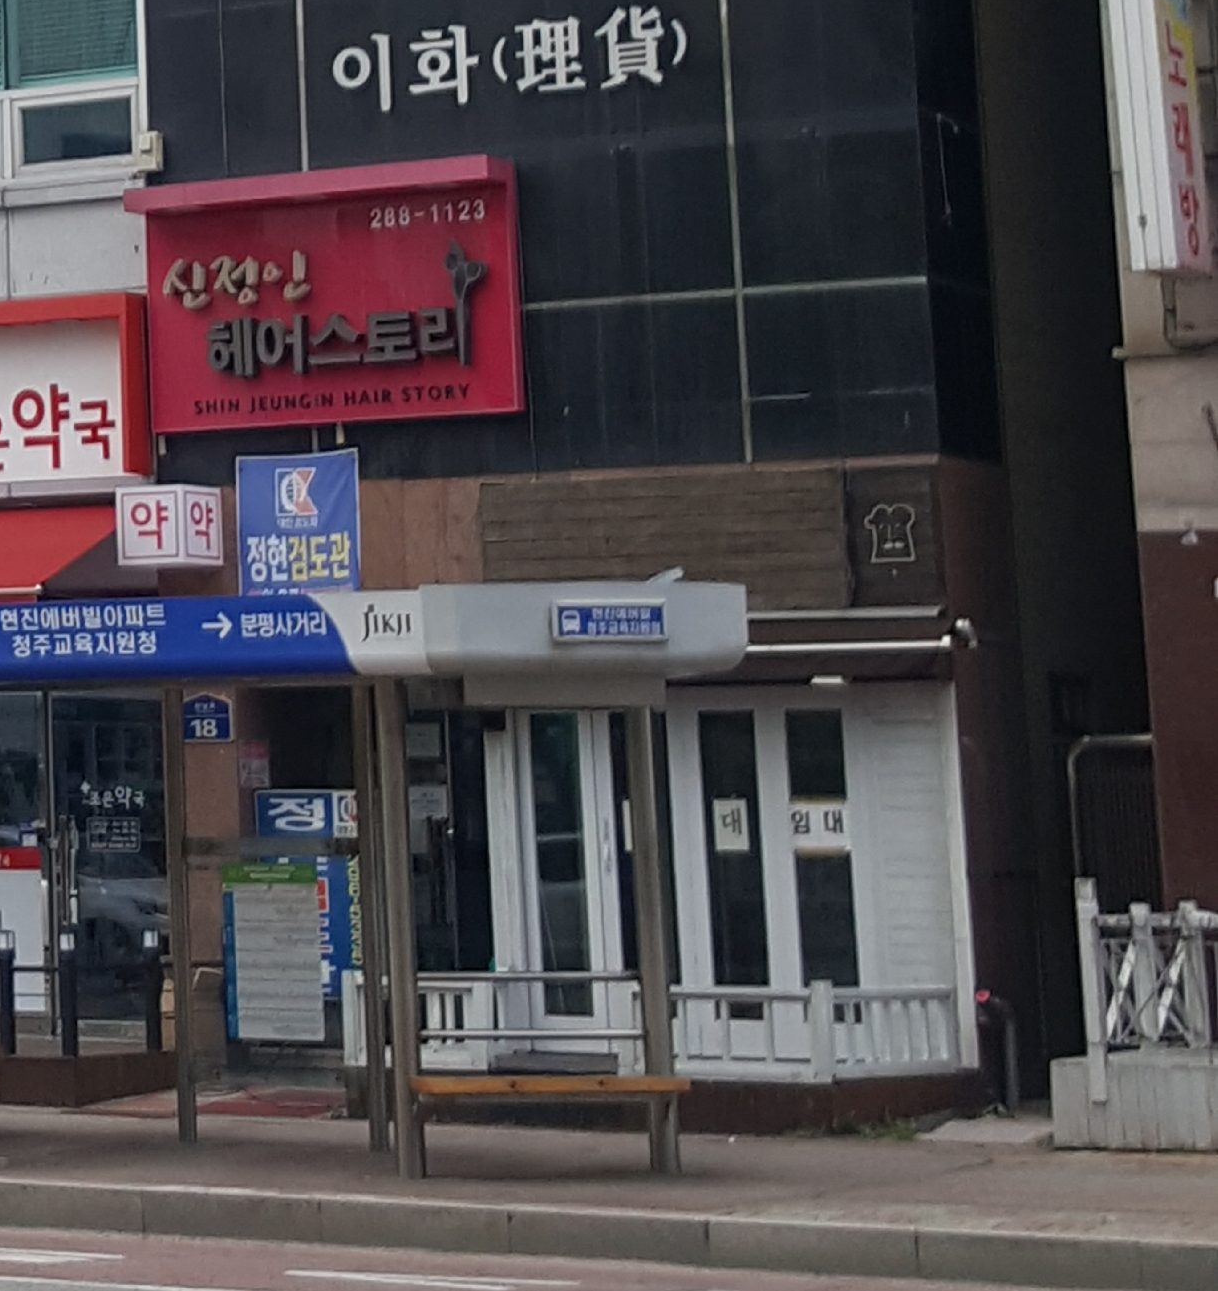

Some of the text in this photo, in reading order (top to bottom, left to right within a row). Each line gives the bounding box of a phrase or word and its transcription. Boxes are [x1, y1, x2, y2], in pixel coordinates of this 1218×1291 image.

[370, 199, 485, 230] 288-1123
[163, 250, 311, 309] 신정인
[208, 307, 472, 377] 헤어스토리
[194, 397, 240, 414] SHIN
[343, 387, 392, 408] HAIR
[401, 383, 471, 403] STORY
[131, 500, 168, 551] 약
[190, 501, 214, 552] 약
[247, 531, 350, 582] 정현검도관
[0, 604, 166, 631] 현진에버빌아파트
[239, 610, 327, 638] 분평사거리
[11, 631, 158, 658] 청주교육지원청
[190, 718, 218, 737] 18
[722, 807, 742, 837] 대
